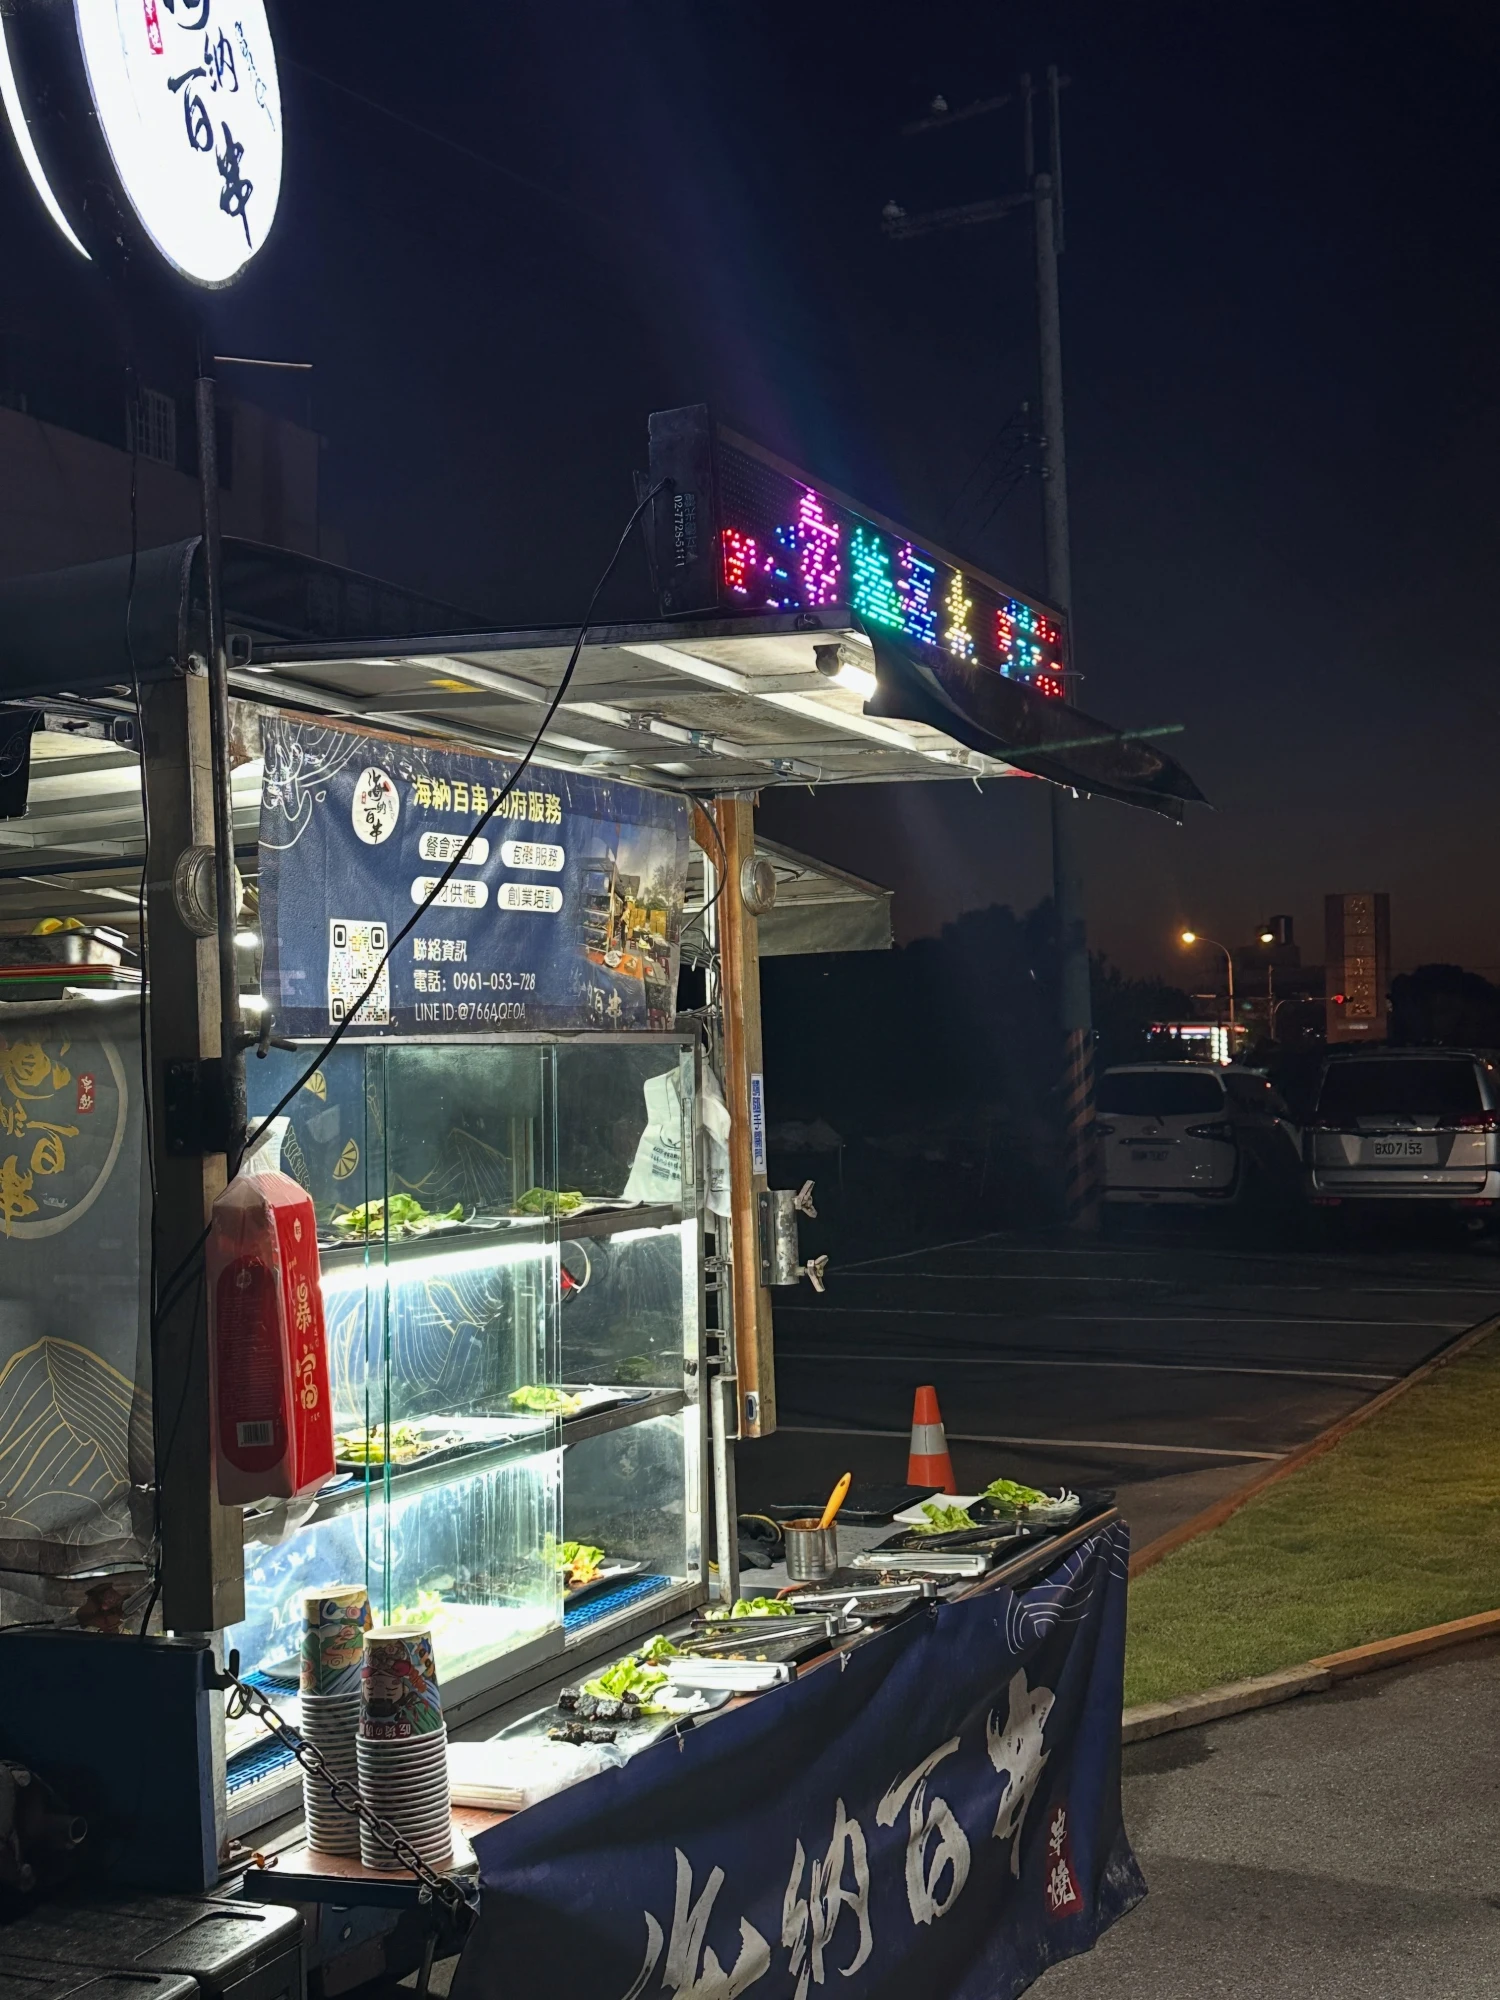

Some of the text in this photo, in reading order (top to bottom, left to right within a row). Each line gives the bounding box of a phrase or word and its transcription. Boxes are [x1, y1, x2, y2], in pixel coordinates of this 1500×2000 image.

[413, 938, 467, 962] 聯絡資訊
[453, 972, 536, 991] 0961-053-728
[414, 1002, 440, 1021] LINE
[1047, 1807, 1077, 1911] 串燒
